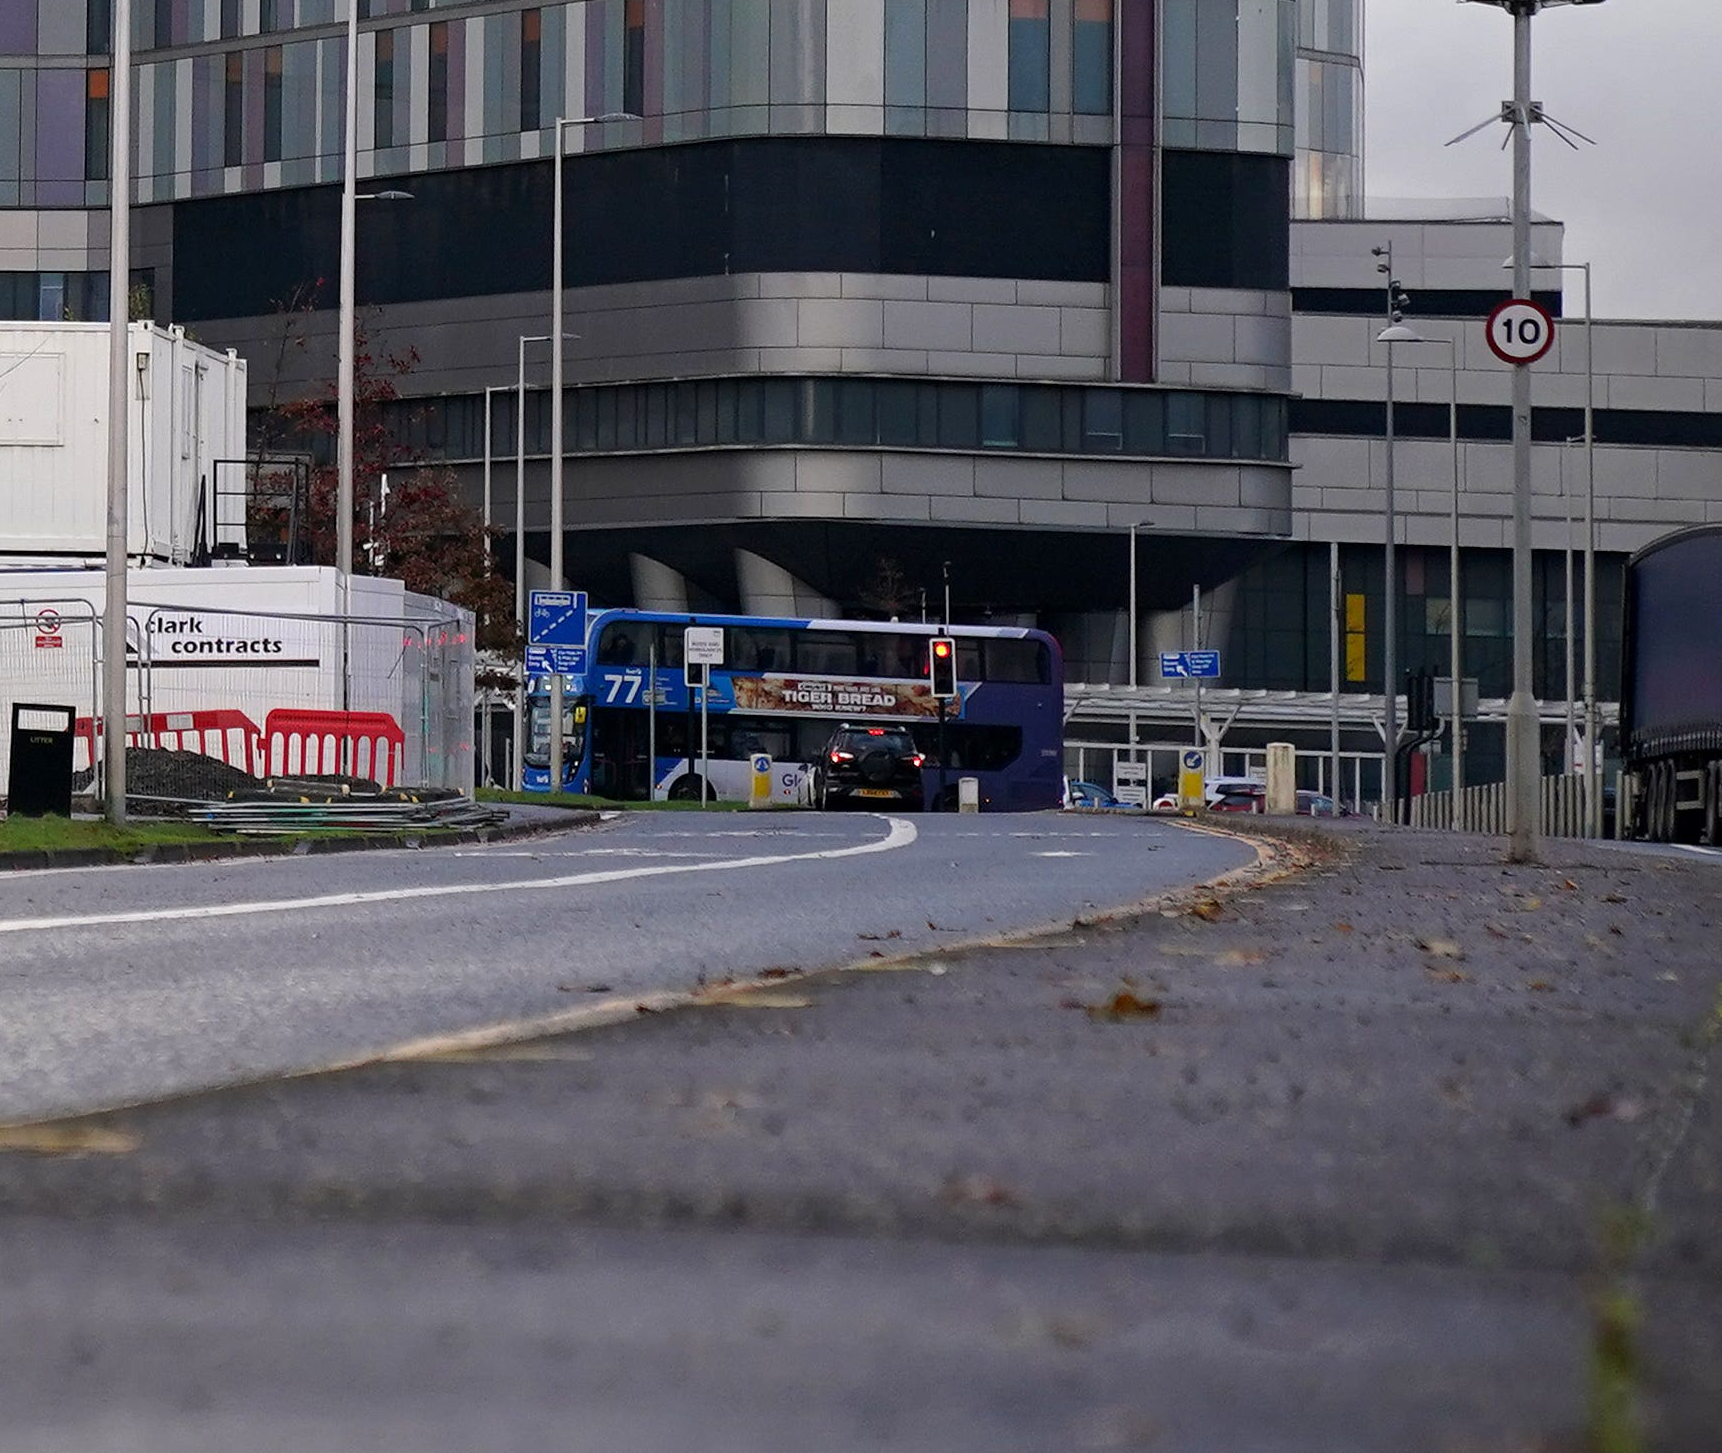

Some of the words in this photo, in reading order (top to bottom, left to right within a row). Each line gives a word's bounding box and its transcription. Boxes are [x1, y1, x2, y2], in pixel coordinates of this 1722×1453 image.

[1502, 318, 1541, 345] 10
[171, 638, 283, 654] contracts
[604, 674, 642, 703] 77
[782, 690, 833, 703] TIGER
[838, 692, 896, 707] BREAD
